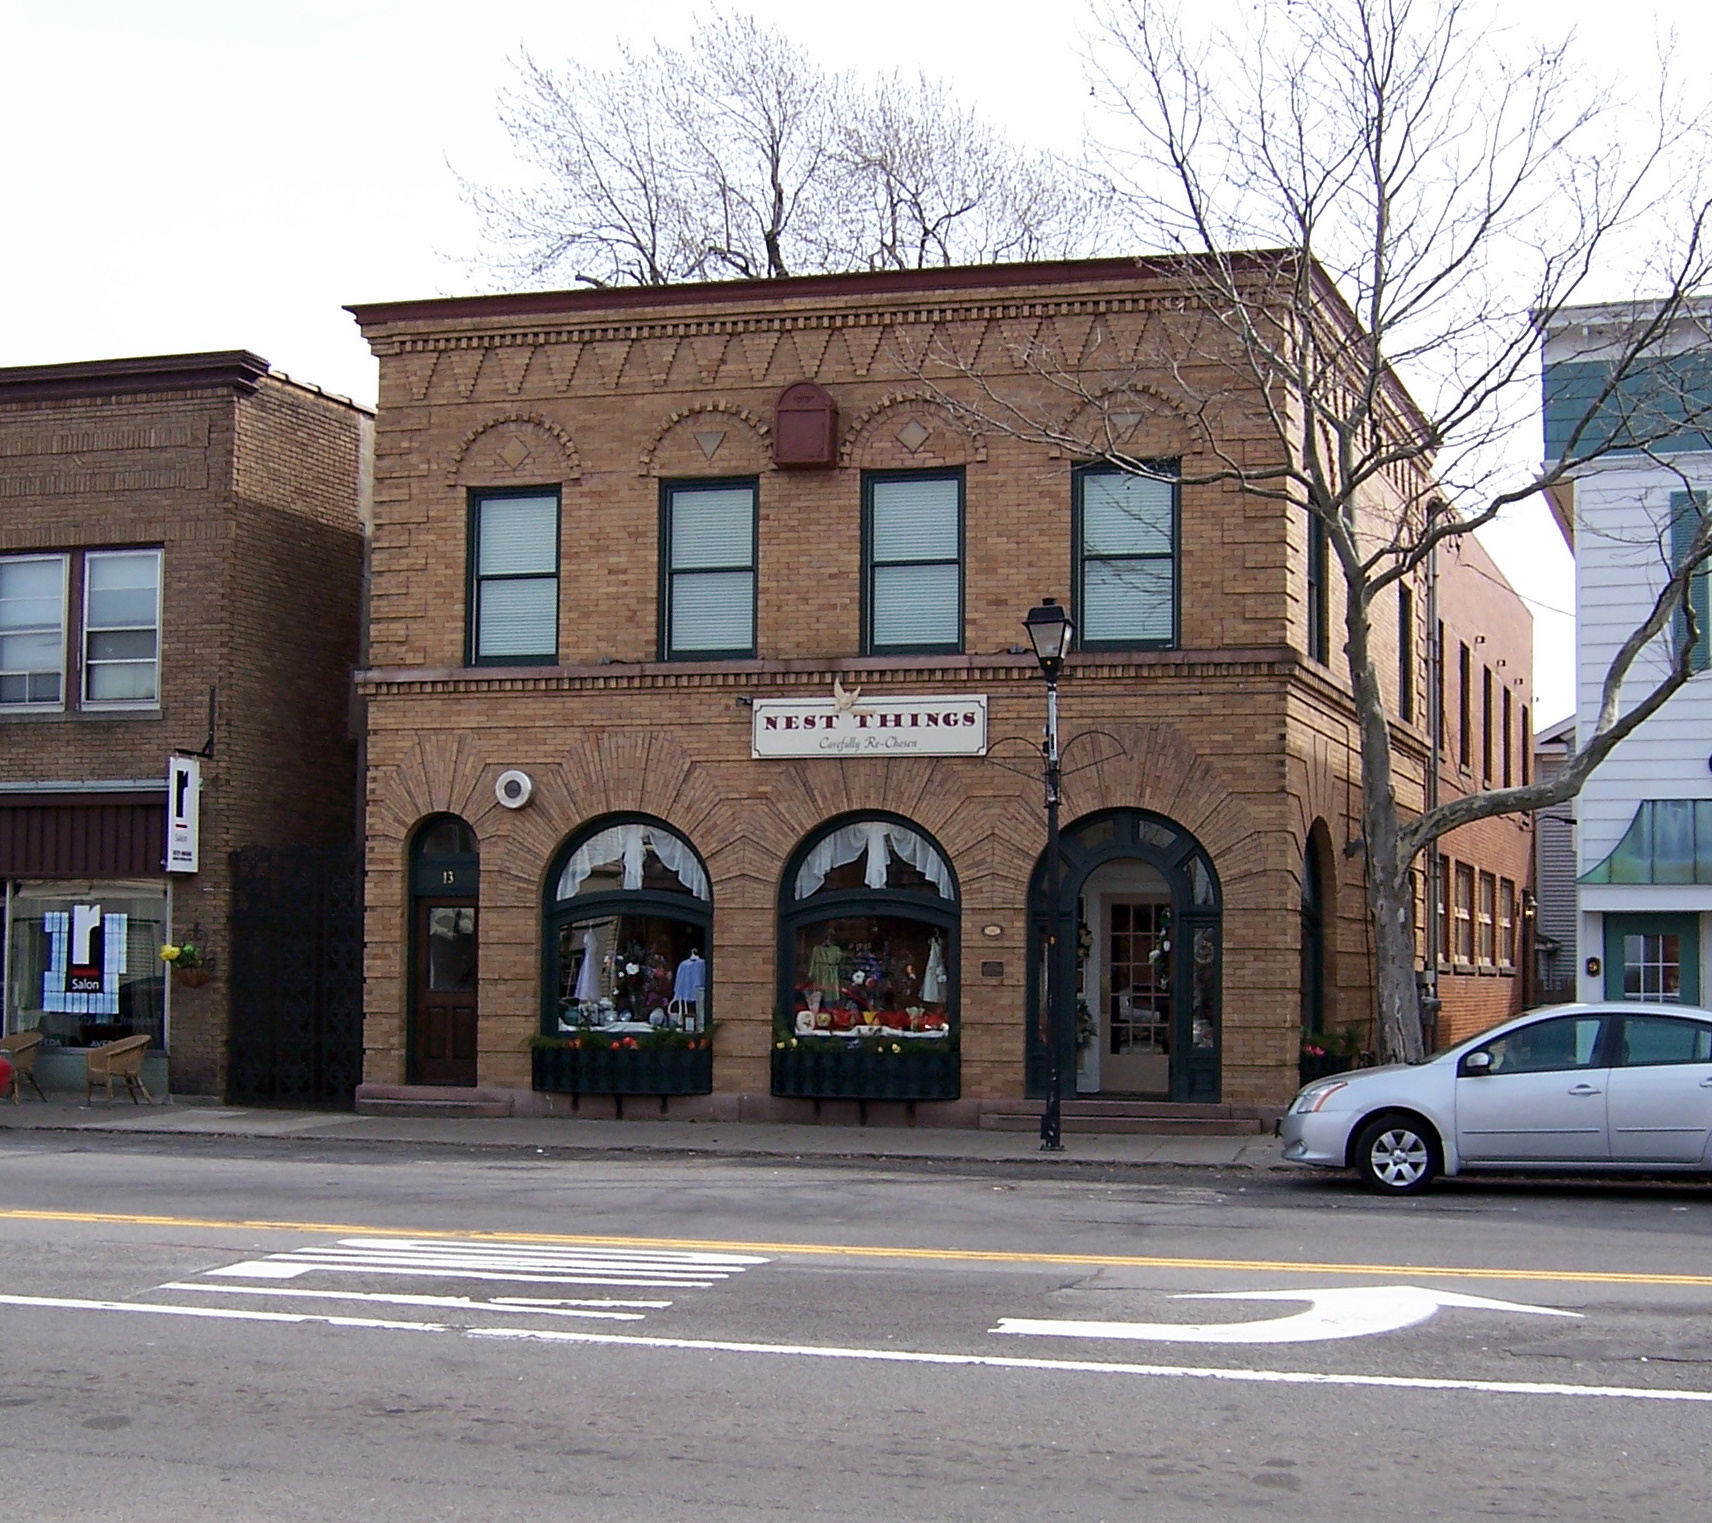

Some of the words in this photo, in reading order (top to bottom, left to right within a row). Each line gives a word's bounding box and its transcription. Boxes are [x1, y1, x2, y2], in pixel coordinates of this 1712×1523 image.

[762, 715, 839, 730] NEST
[853, 711, 976, 729] THINGS
[819, 736, 860, 752] Carefully
[864, 735, 918, 749] Re-Chosen
[443, 870, 454, 884] 13
[72, 978, 99, 990] Salon
